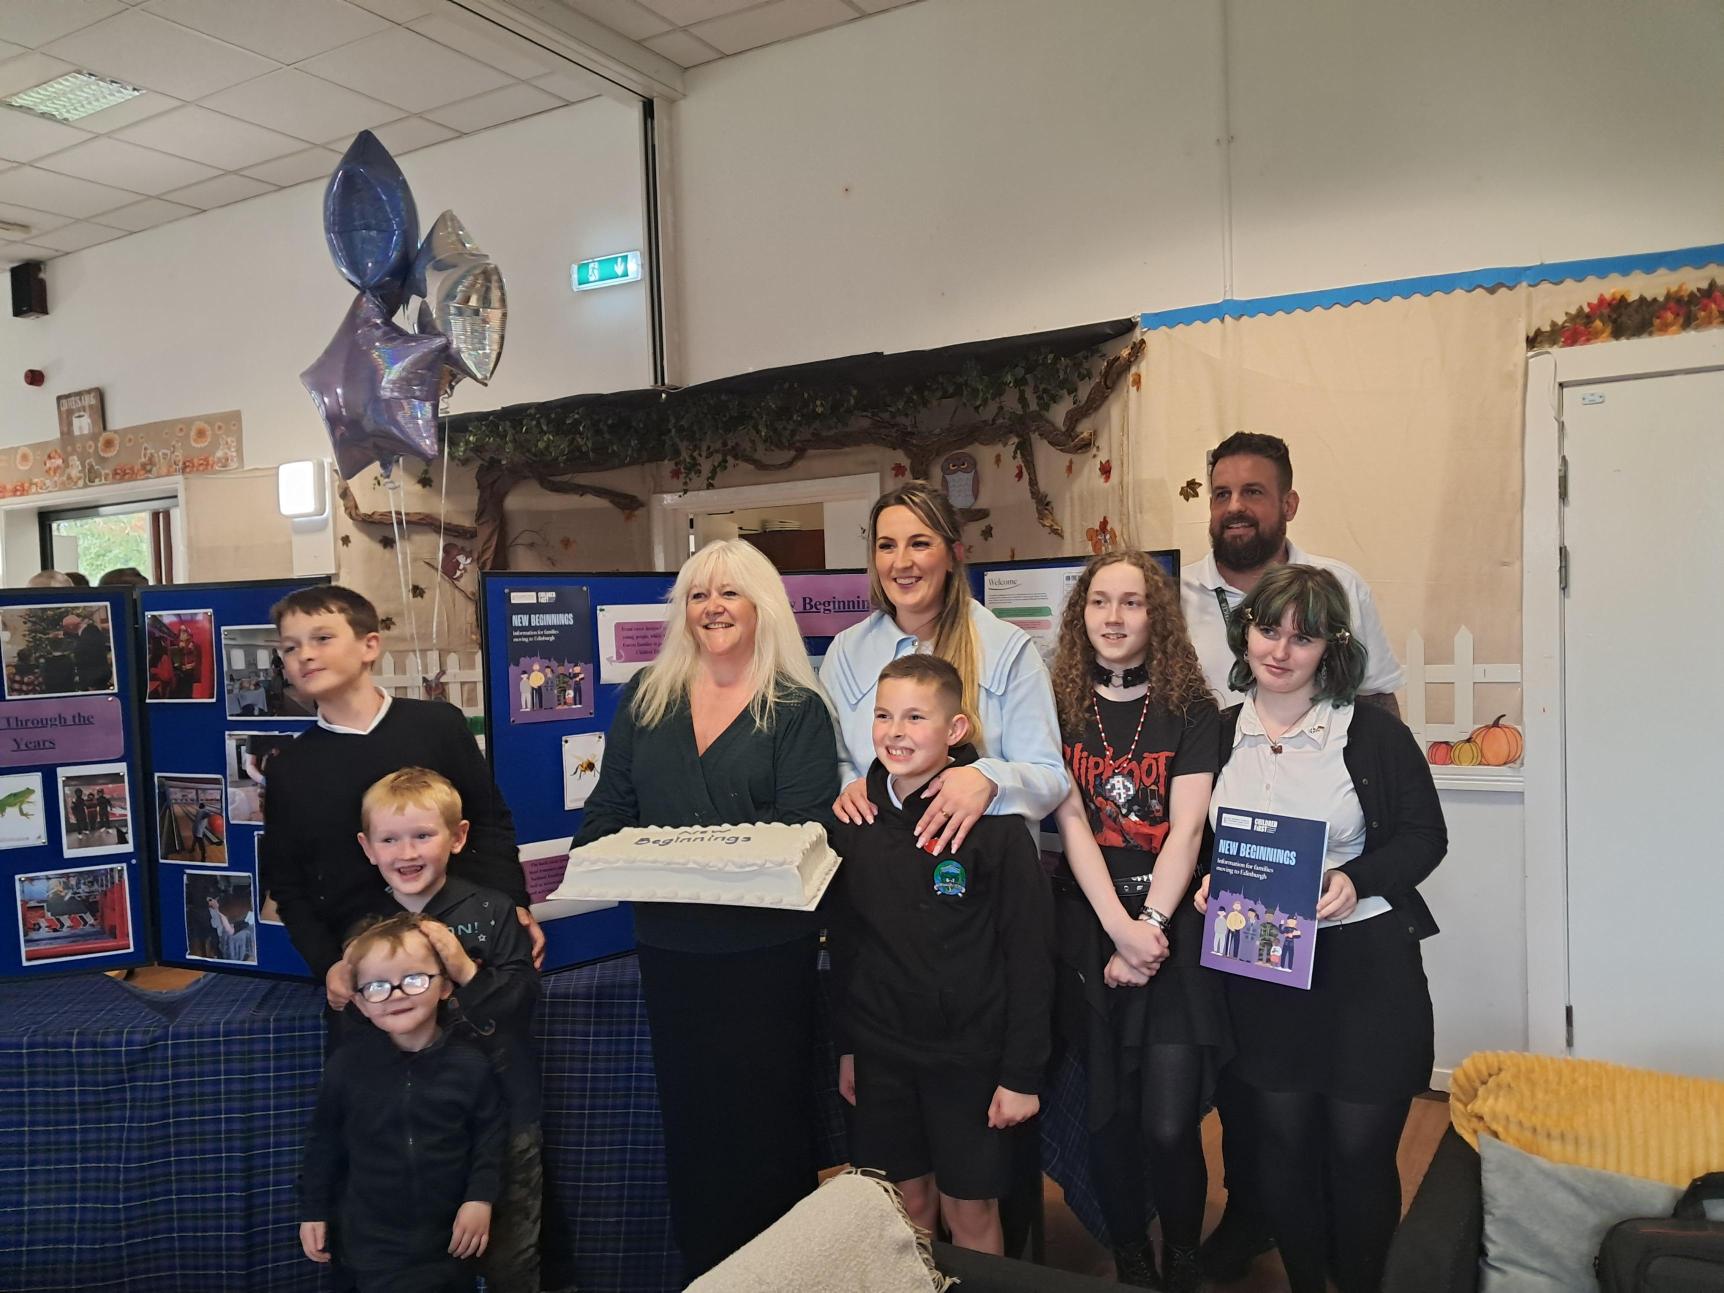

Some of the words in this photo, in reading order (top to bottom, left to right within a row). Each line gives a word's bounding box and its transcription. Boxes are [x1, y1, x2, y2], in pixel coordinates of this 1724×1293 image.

[802, 595, 869, 614] Beginnin
[512, 614, 529, 627] NEW
[530, 613, 574, 627] BEGINNINGS
[5, 713, 67, 728] Through
[71, 712, 95, 725] the
[12, 738, 56, 750] Years
[634, 834, 752, 847] Beginnings
[1218, 839, 1239, 856] NEW
[1239, 842, 1297, 866] BEGINNINGS
[1215, 866, 1233, 875] moving
[1216, 857, 1245, 868] Information
[1245, 862, 1253, 870] for
[1253, 864, 1274, 873] families
